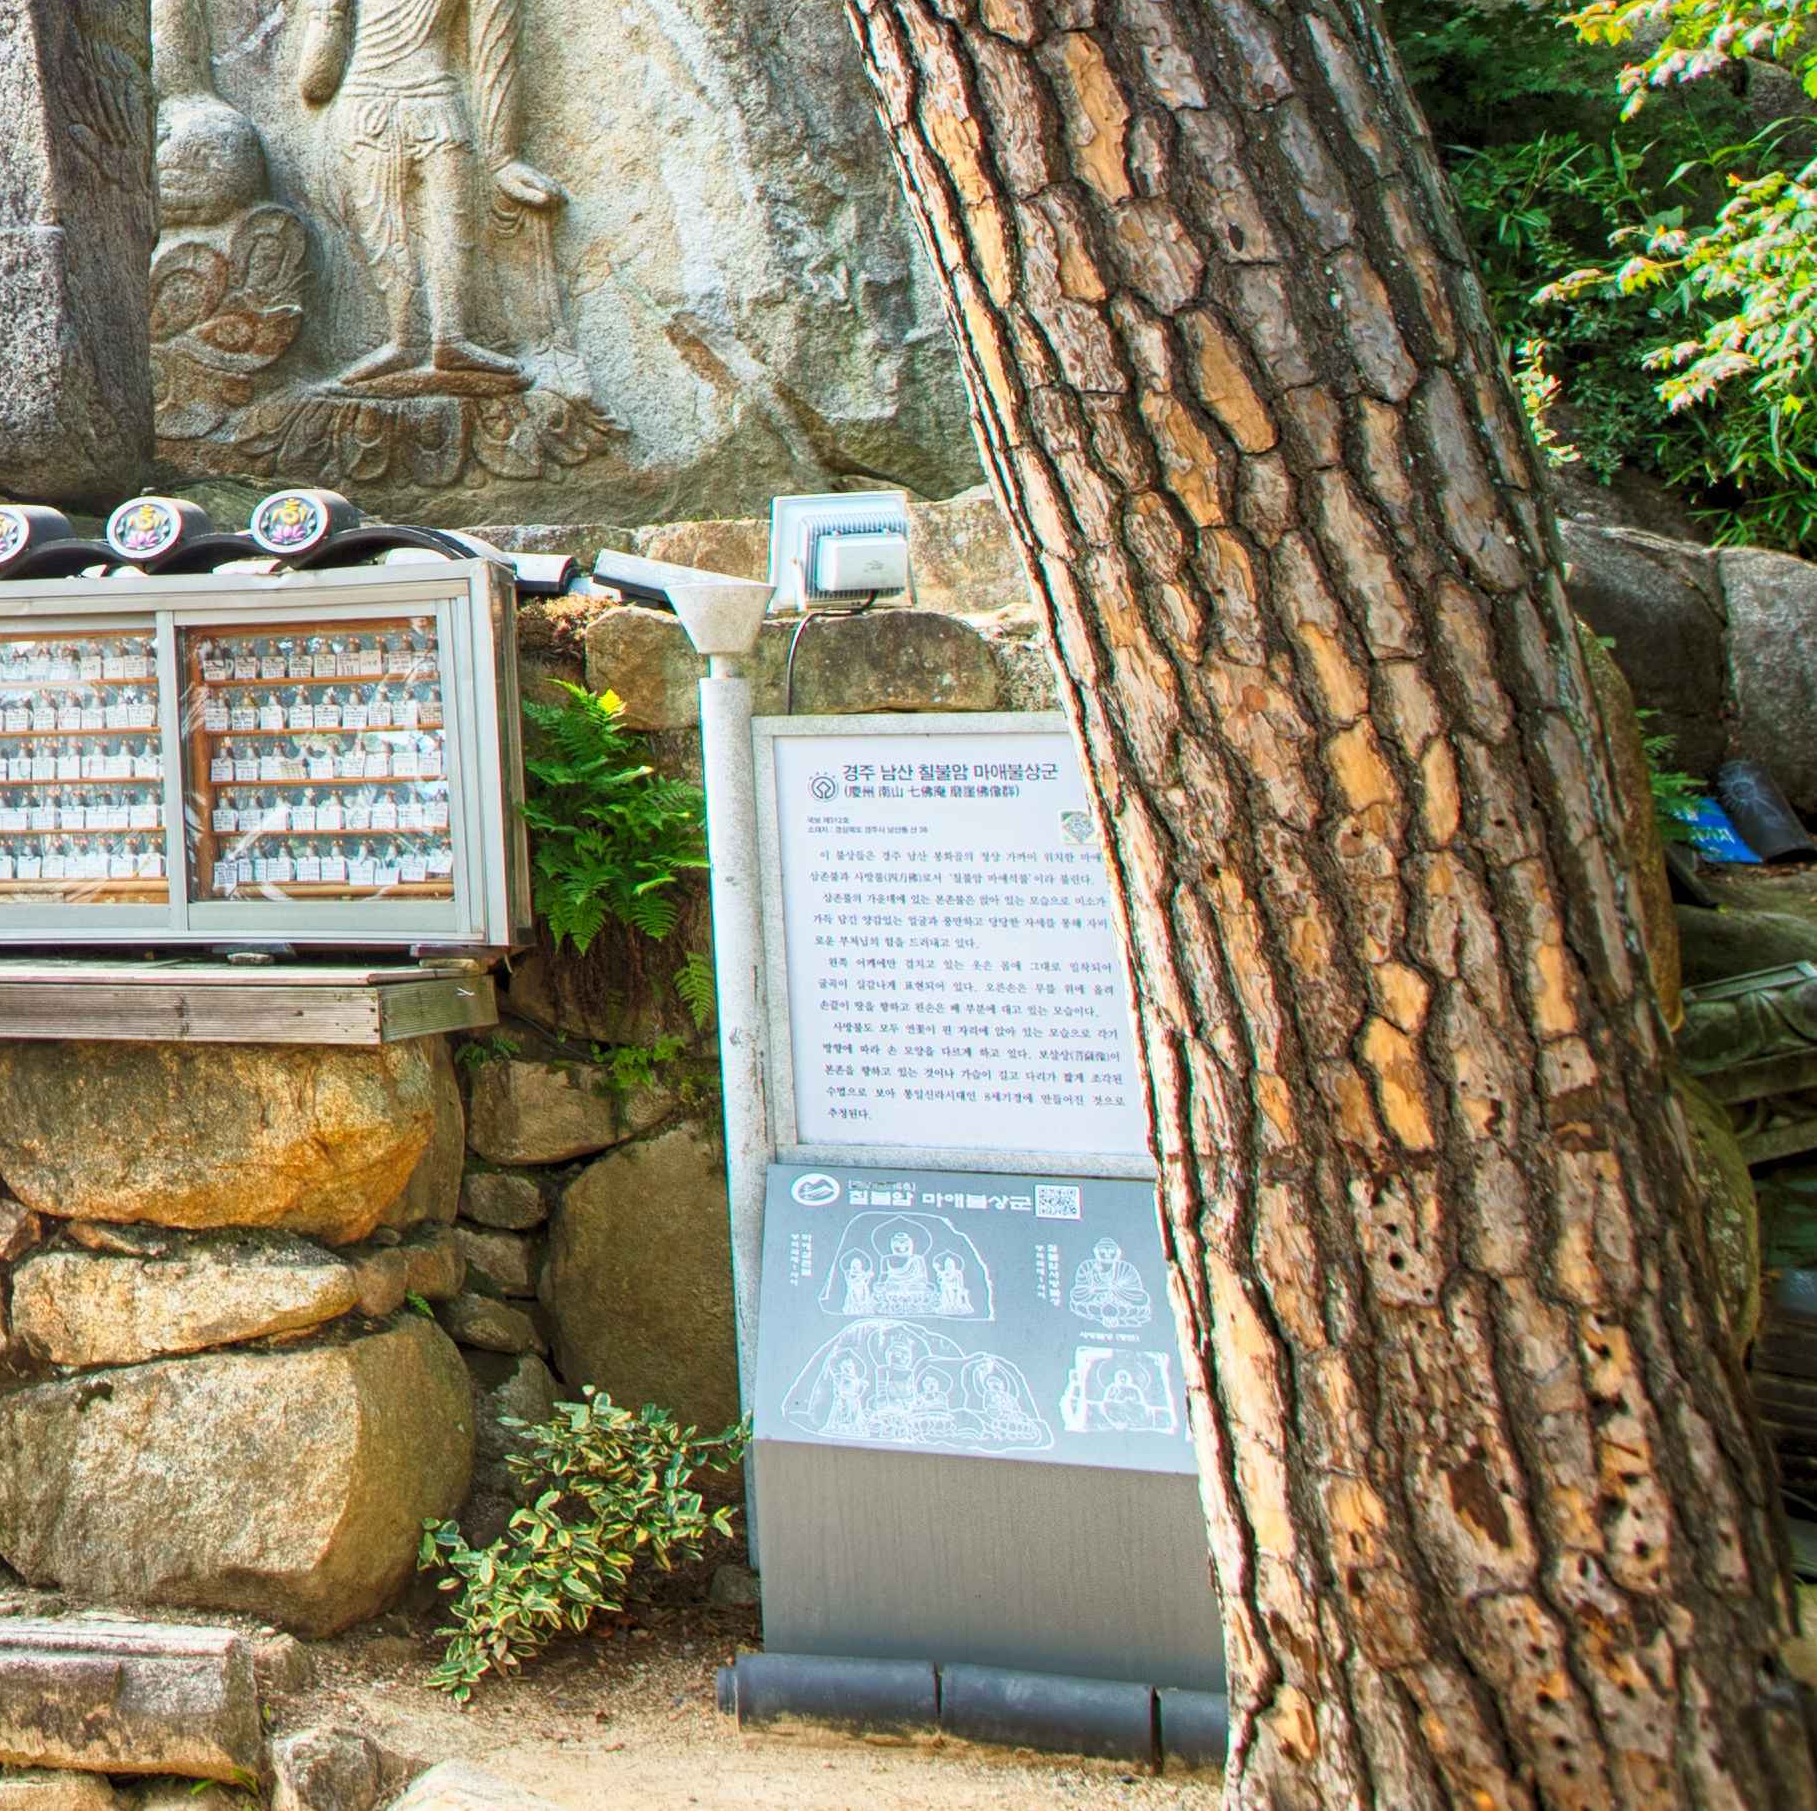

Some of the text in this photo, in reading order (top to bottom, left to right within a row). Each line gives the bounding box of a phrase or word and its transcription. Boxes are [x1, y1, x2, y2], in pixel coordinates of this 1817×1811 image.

[843, 764, 1058, 781] 경주 남산 칠불암 마애불상군
